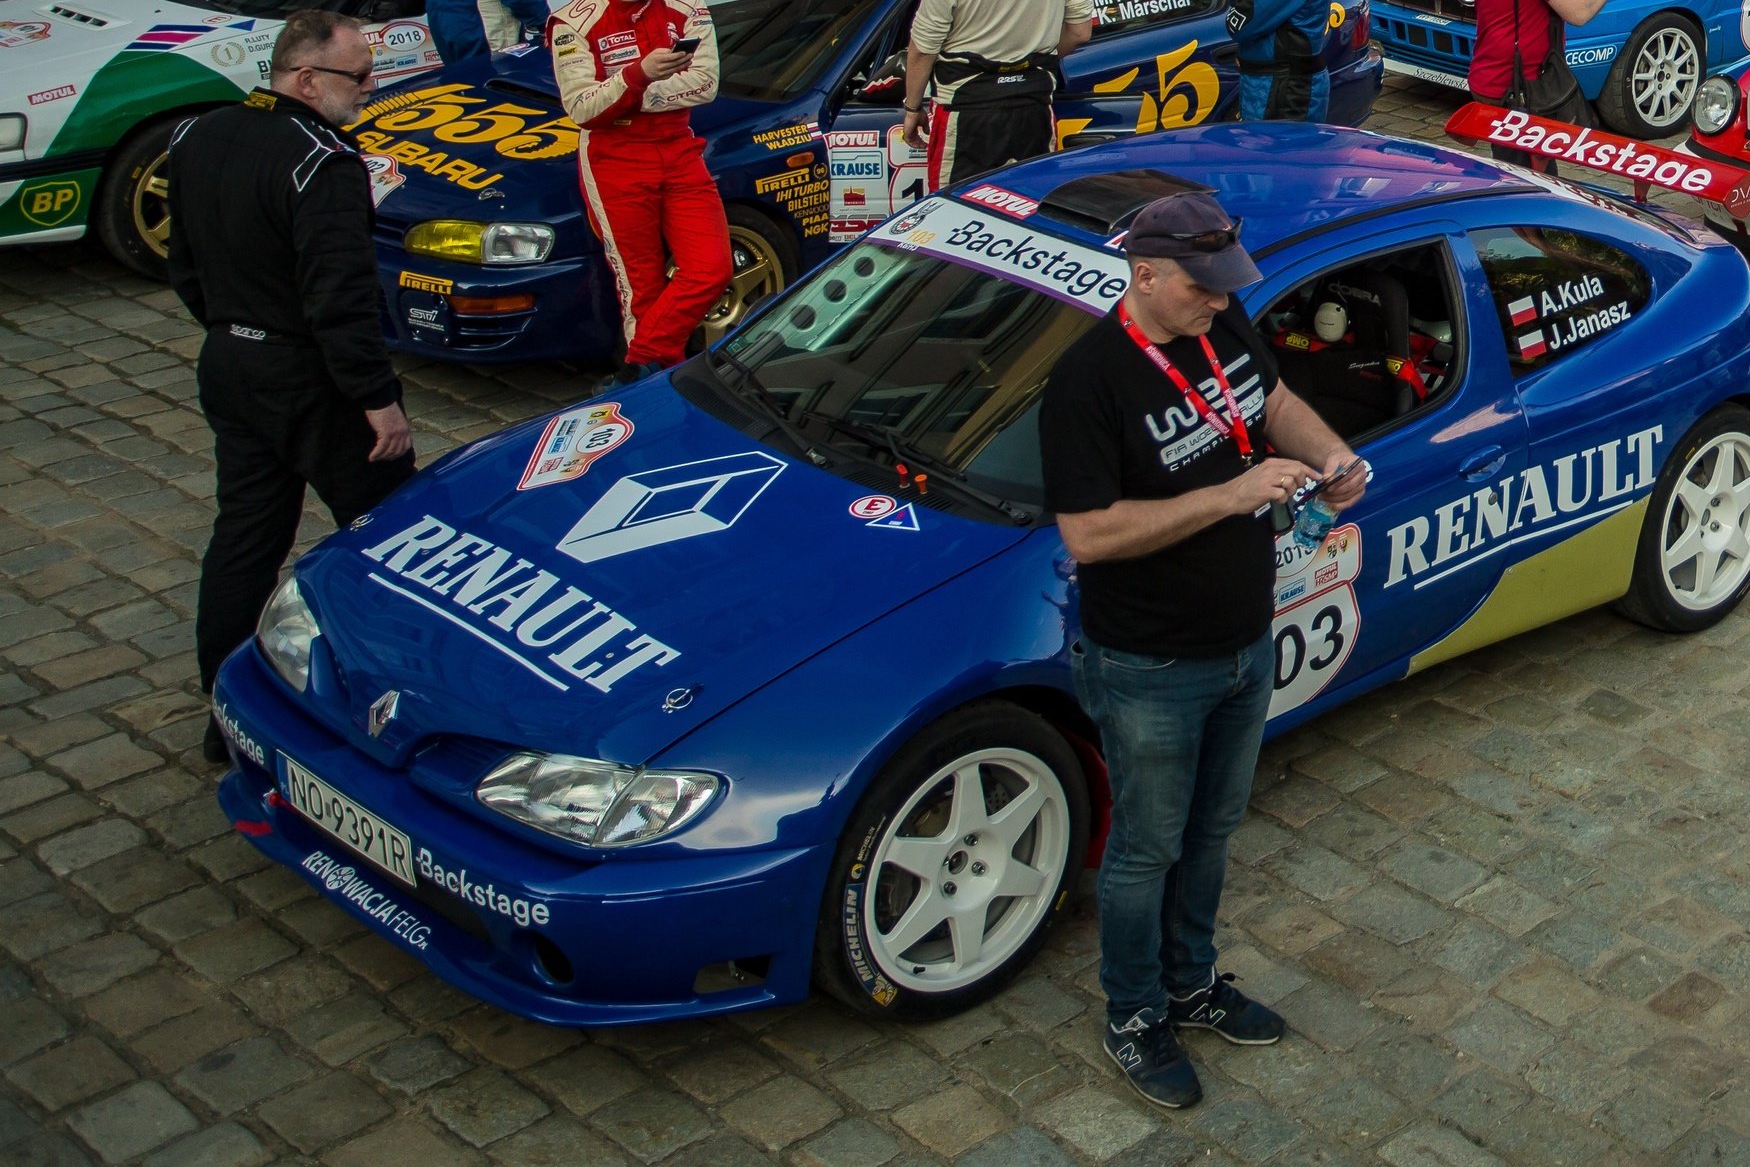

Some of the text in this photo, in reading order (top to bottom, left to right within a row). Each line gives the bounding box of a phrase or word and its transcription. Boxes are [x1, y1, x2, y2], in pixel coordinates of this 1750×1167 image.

[1098, 7, 1116, 26] K.
[389, 31, 423, 46] 2018
[609, 34, 635, 45] TOTAL
[30, 85, 75, 104] MOTUL
[666, 81, 714, 103] CITROËN
[753, 125, 808, 143] HARVESTER
[766, 134, 812, 150] WŁADZIU
[355, 131, 504, 190] SUBARU
[1489, 108, 1713, 193] Backstage
[755, 168, 809, 194] PIRELLI
[776, 180, 829, 202] IHI TURBO
[32, 188, 74, 215] BP
[788, 192, 830, 212] BILSTEIN
[794, 204, 830, 218] KENWOOD
[967, 186, 1040, 216] MOTUL
[803, 214, 829, 226] PIAA
[805, 223, 828, 237] NGK
[905, 229, 937, 245] 103
[945, 220, 1127, 299] Backstage
[400, 271, 453, 295] PIRELLI
[1542, 274, 1605, 317] A.Kula
[1550, 301, 1632, 350] J.Janasz
[1383, 424, 1666, 589] RENAULT
[1315, 563, 1338, 578] MOTUL
[361, 514, 683, 694] RENAULT
[1280, 586, 1305, 602] KRAUSE
[288, 777, 414, 886] NO 9391R
[416, 846, 550, 928] Backstage
[846, 887, 874, 982] MICHELIN
